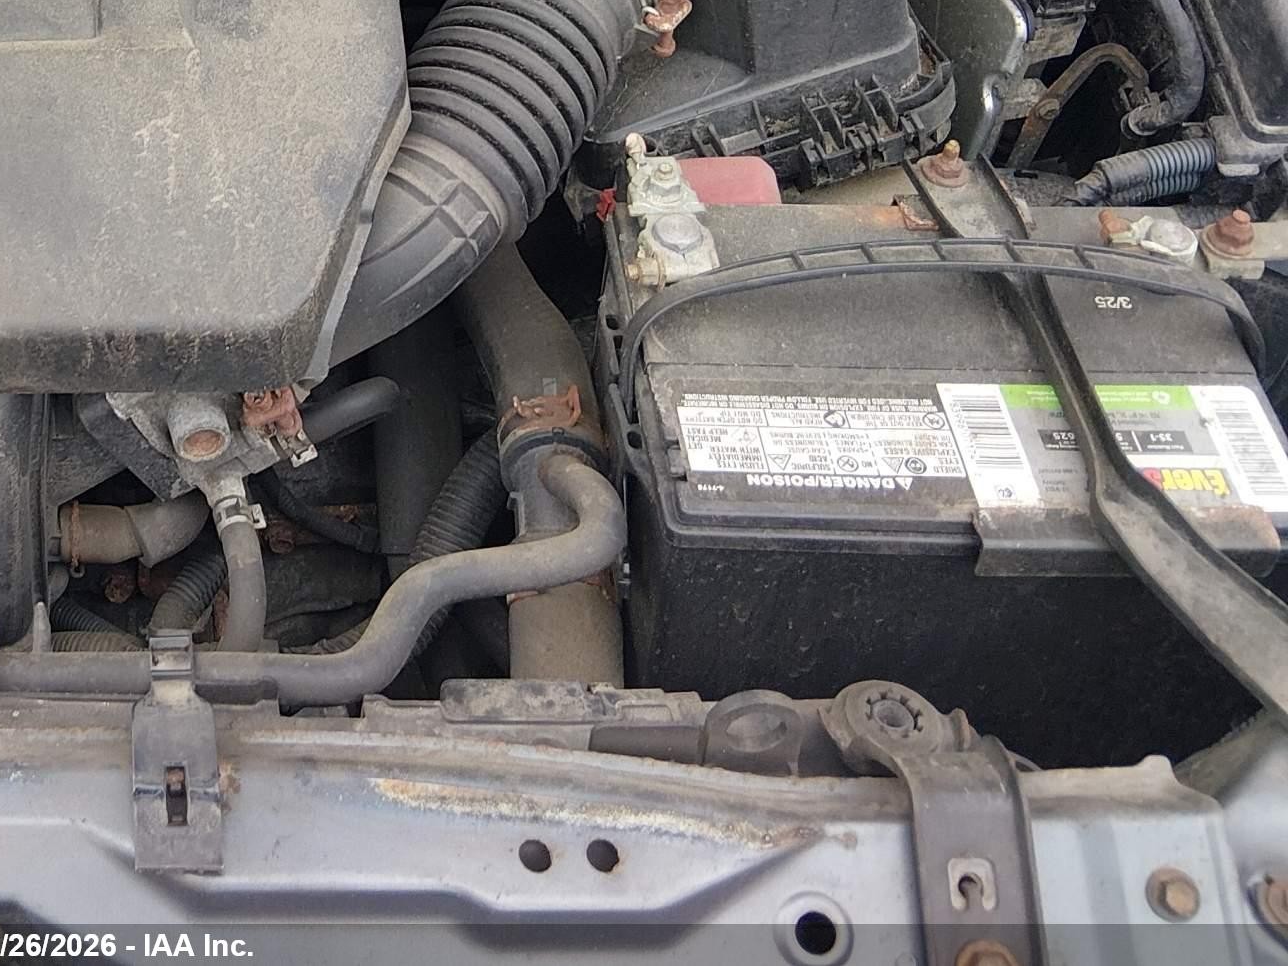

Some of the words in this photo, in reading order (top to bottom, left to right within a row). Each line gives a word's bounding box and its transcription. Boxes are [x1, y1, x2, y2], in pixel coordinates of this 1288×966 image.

[1094, 296, 1132, 310] 3/25
[1052, 432, 1076, 440] 625
[746, 474, 896, 490] DANGER/POISON
